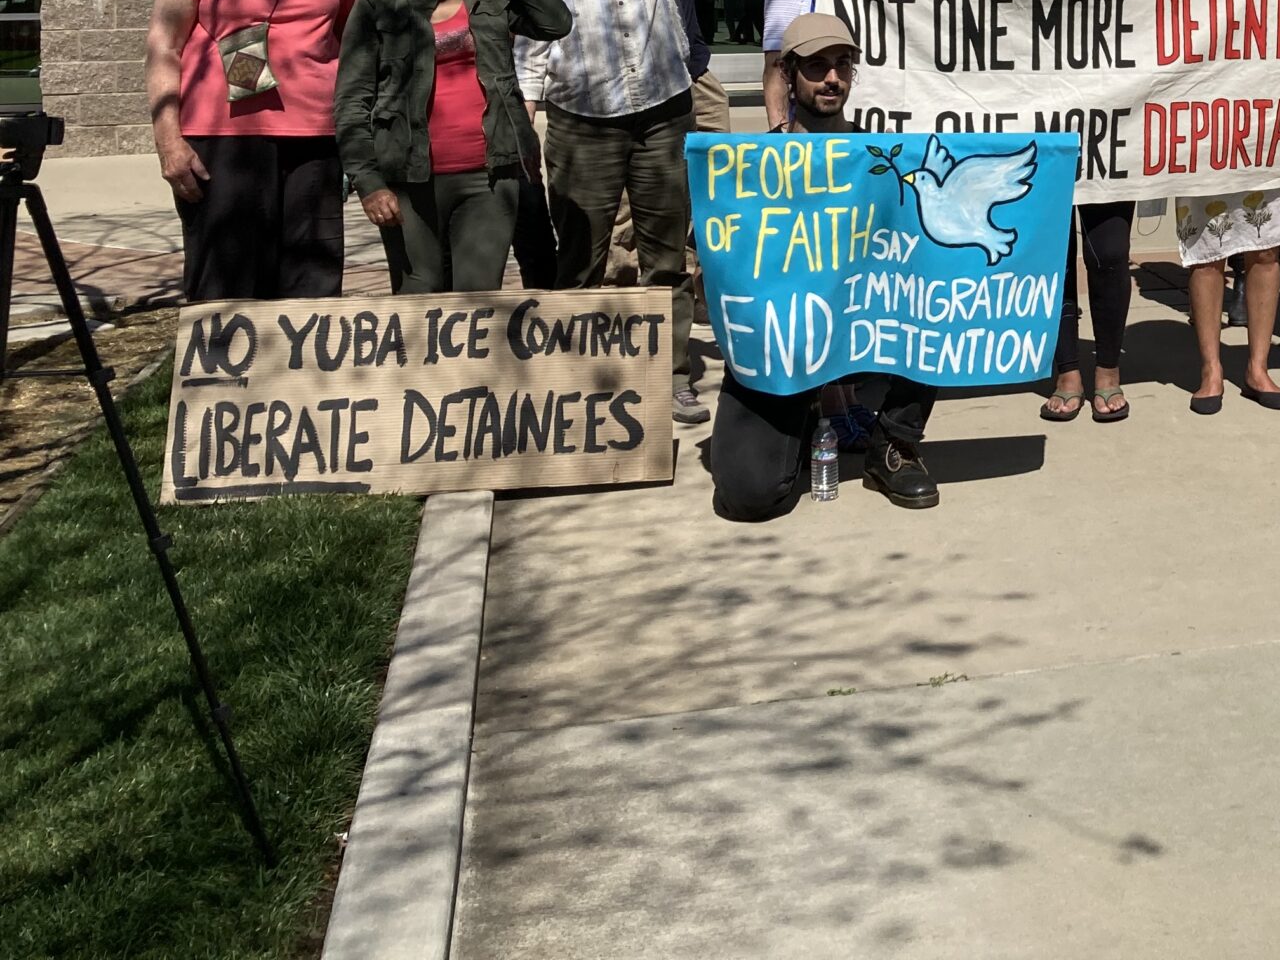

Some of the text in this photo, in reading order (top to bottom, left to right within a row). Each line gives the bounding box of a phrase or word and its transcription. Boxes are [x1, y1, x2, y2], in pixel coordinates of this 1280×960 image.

[706, 138, 853, 200] PEOPLE
[705, 202, 920, 280] OF FAITH SAY
[720, 292, 834, 379] END
[843, 271, 1059, 323] IMMIGRATION
[180, 298, 666, 378] NO YUBA ICE CONTRACT
[848, 318, 1048, 375] DETENTION
[171, 385, 643, 489] LIBERATE DETAINEES
